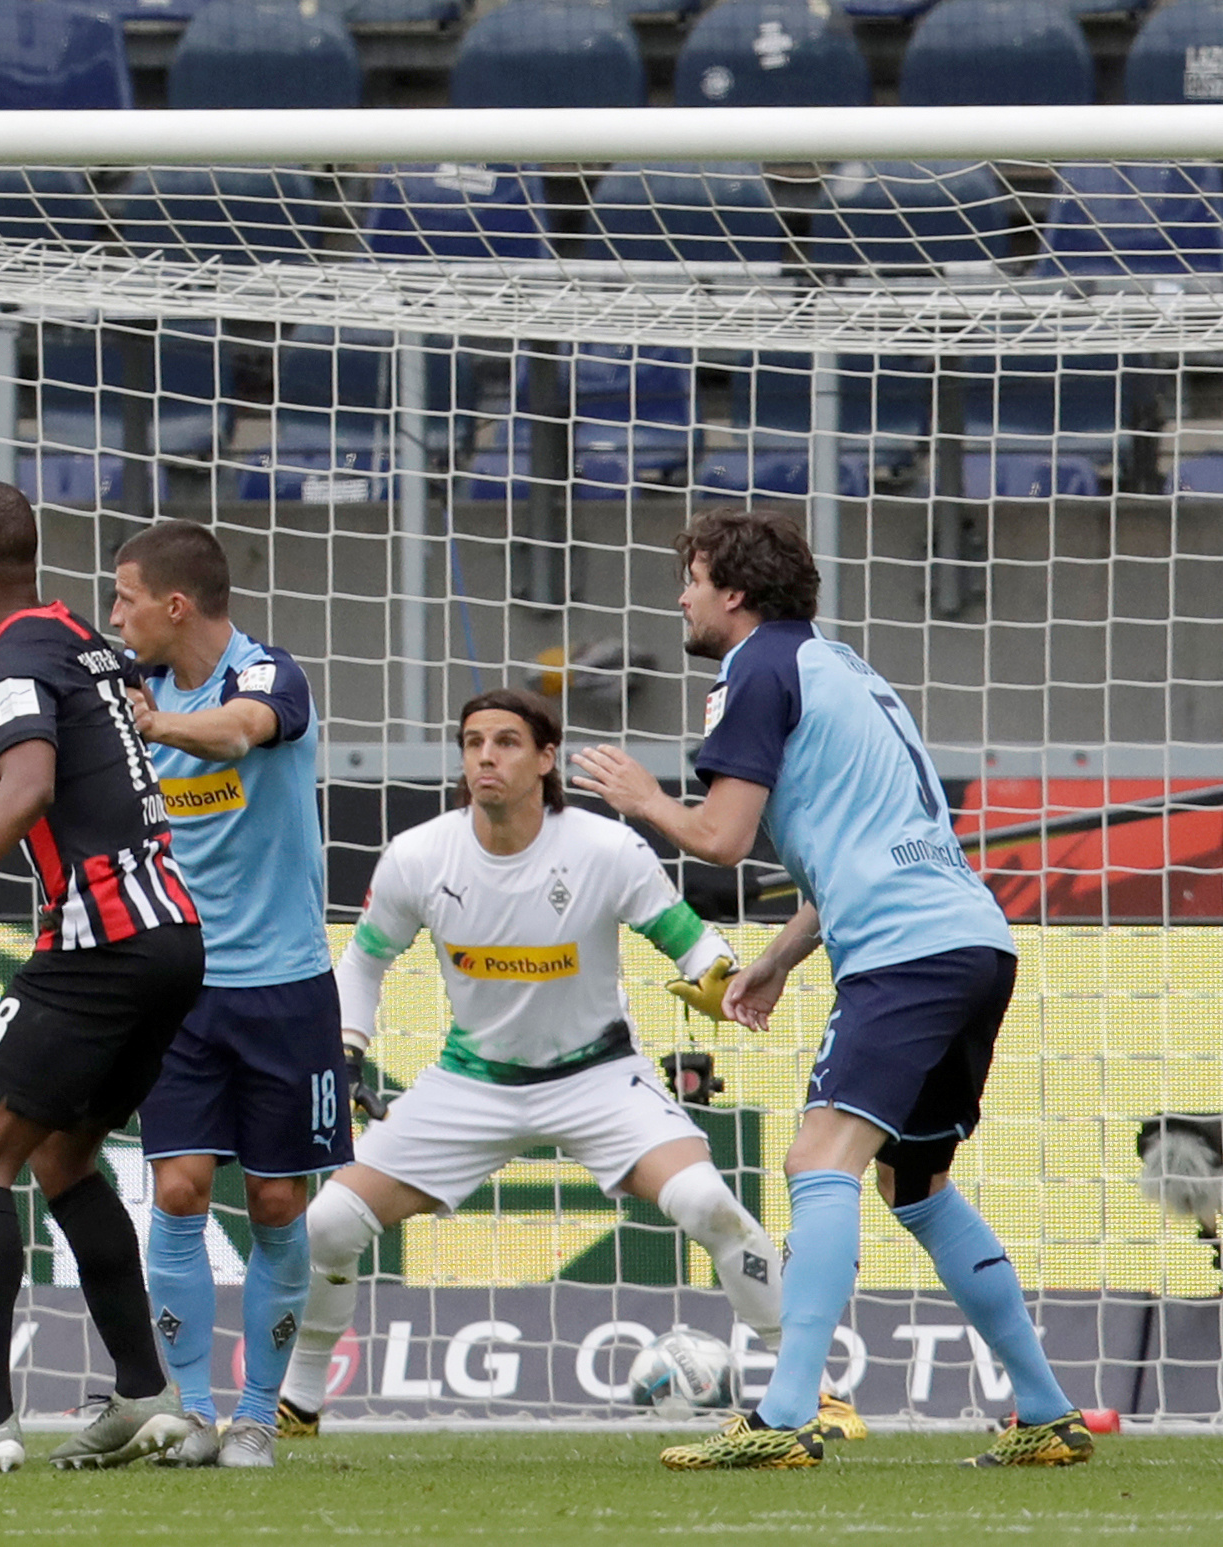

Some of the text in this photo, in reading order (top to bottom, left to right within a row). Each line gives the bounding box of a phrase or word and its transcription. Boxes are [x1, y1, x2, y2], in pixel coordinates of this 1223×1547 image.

[162, 781, 241, 808] ostbank
[484, 953, 575, 974] Postbank
[311, 1068, 337, 1131] 18
[380, 1320, 523, 1399] LG
